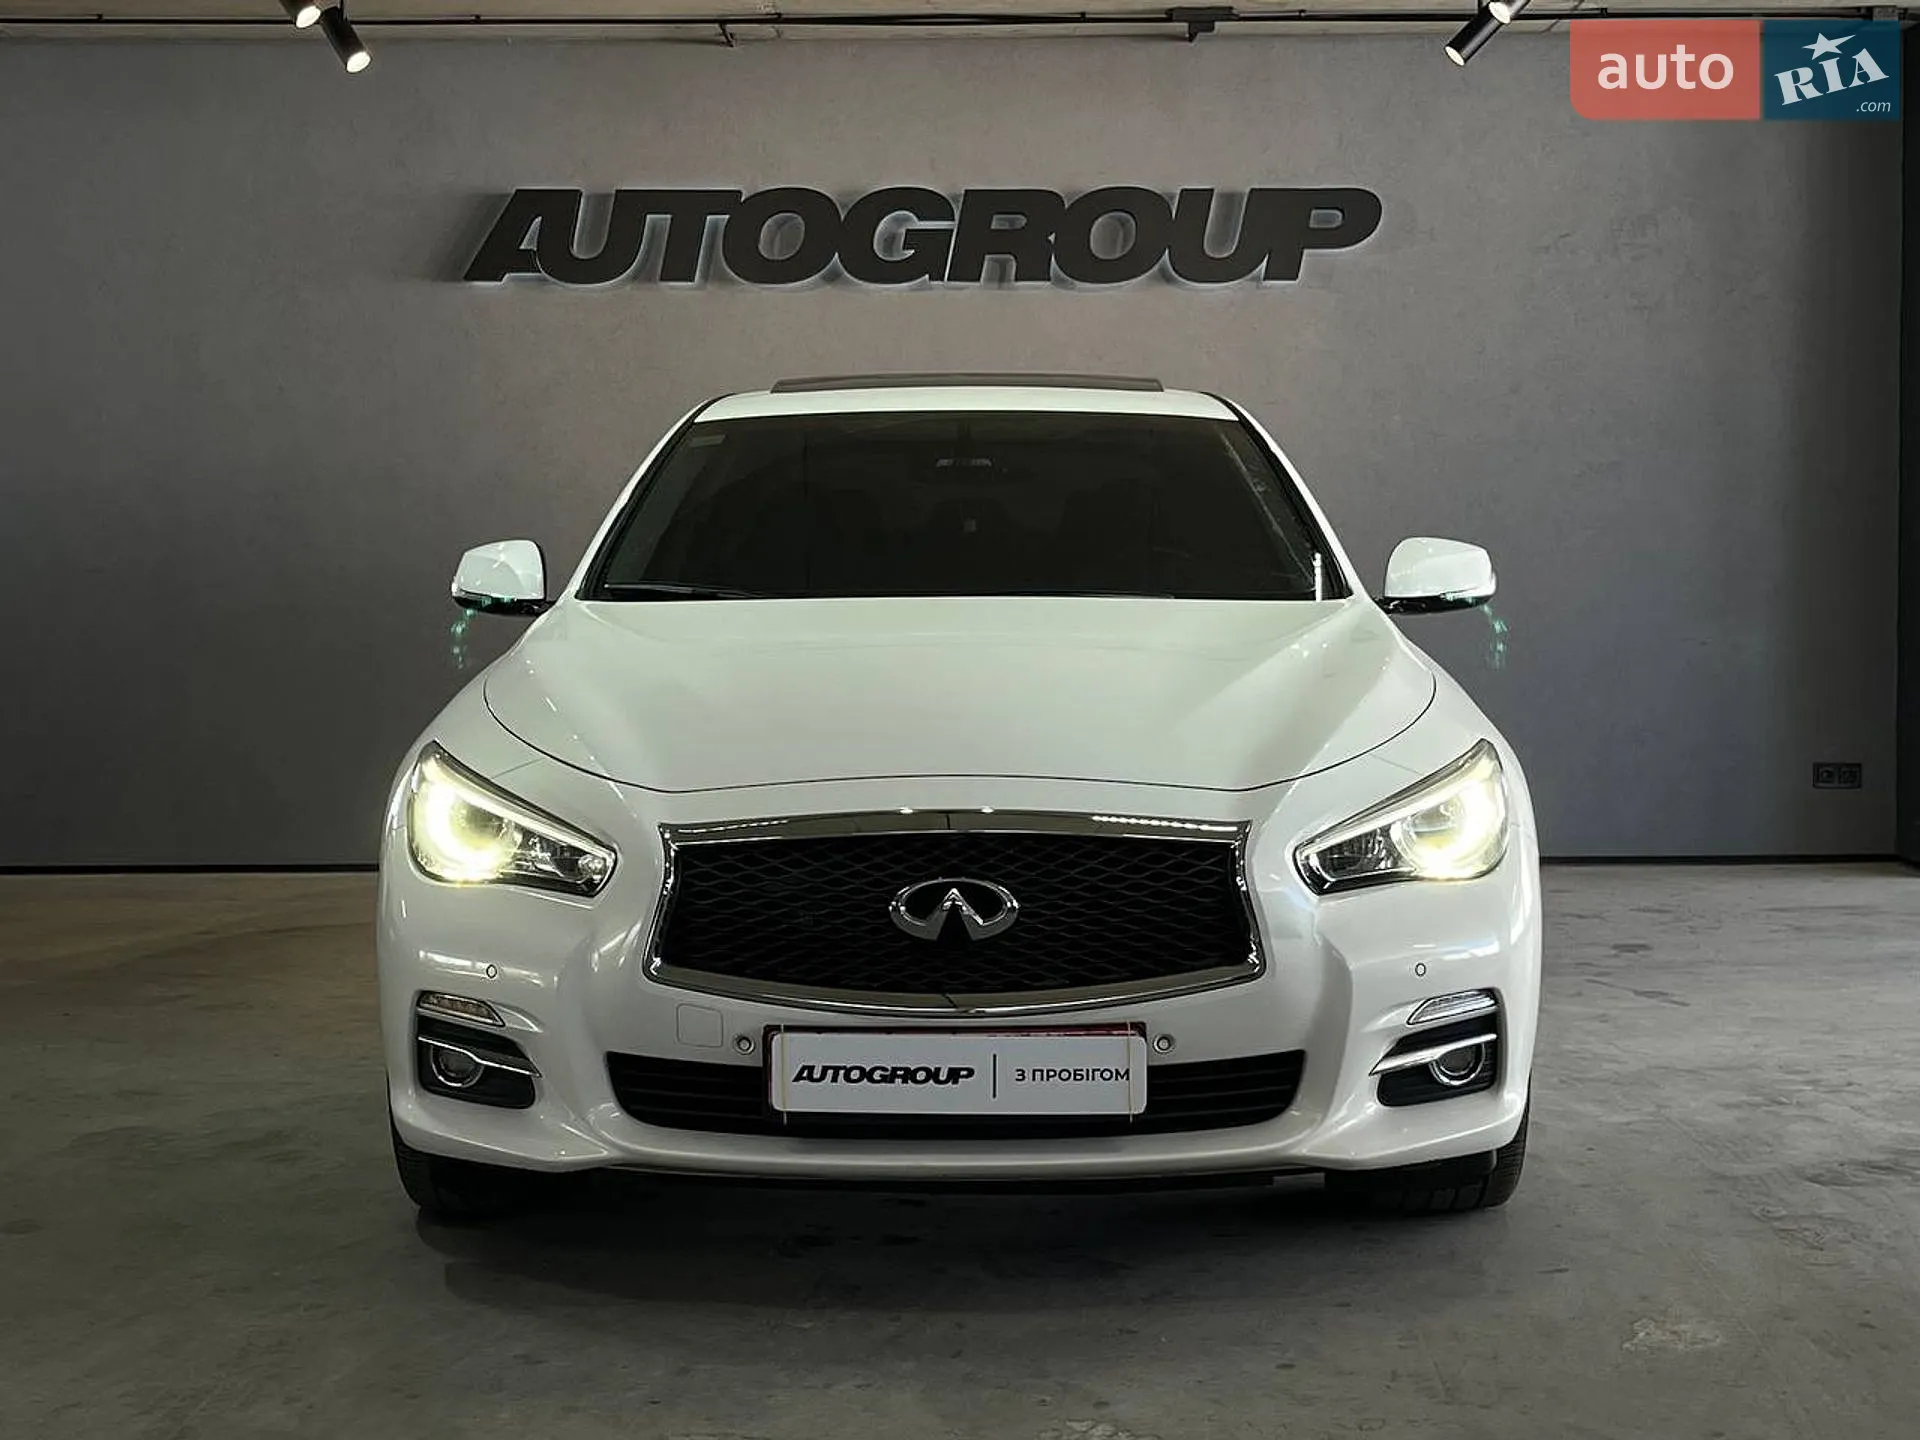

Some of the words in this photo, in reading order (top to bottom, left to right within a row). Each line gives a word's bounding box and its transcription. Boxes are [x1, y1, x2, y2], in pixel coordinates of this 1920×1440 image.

[463, 186, 1384, 288] AUTOGROUP
[791, 1064, 976, 1086] AUTOGROUP
[1031, 1067, 1131, 1083] ПРОБІГОМ
